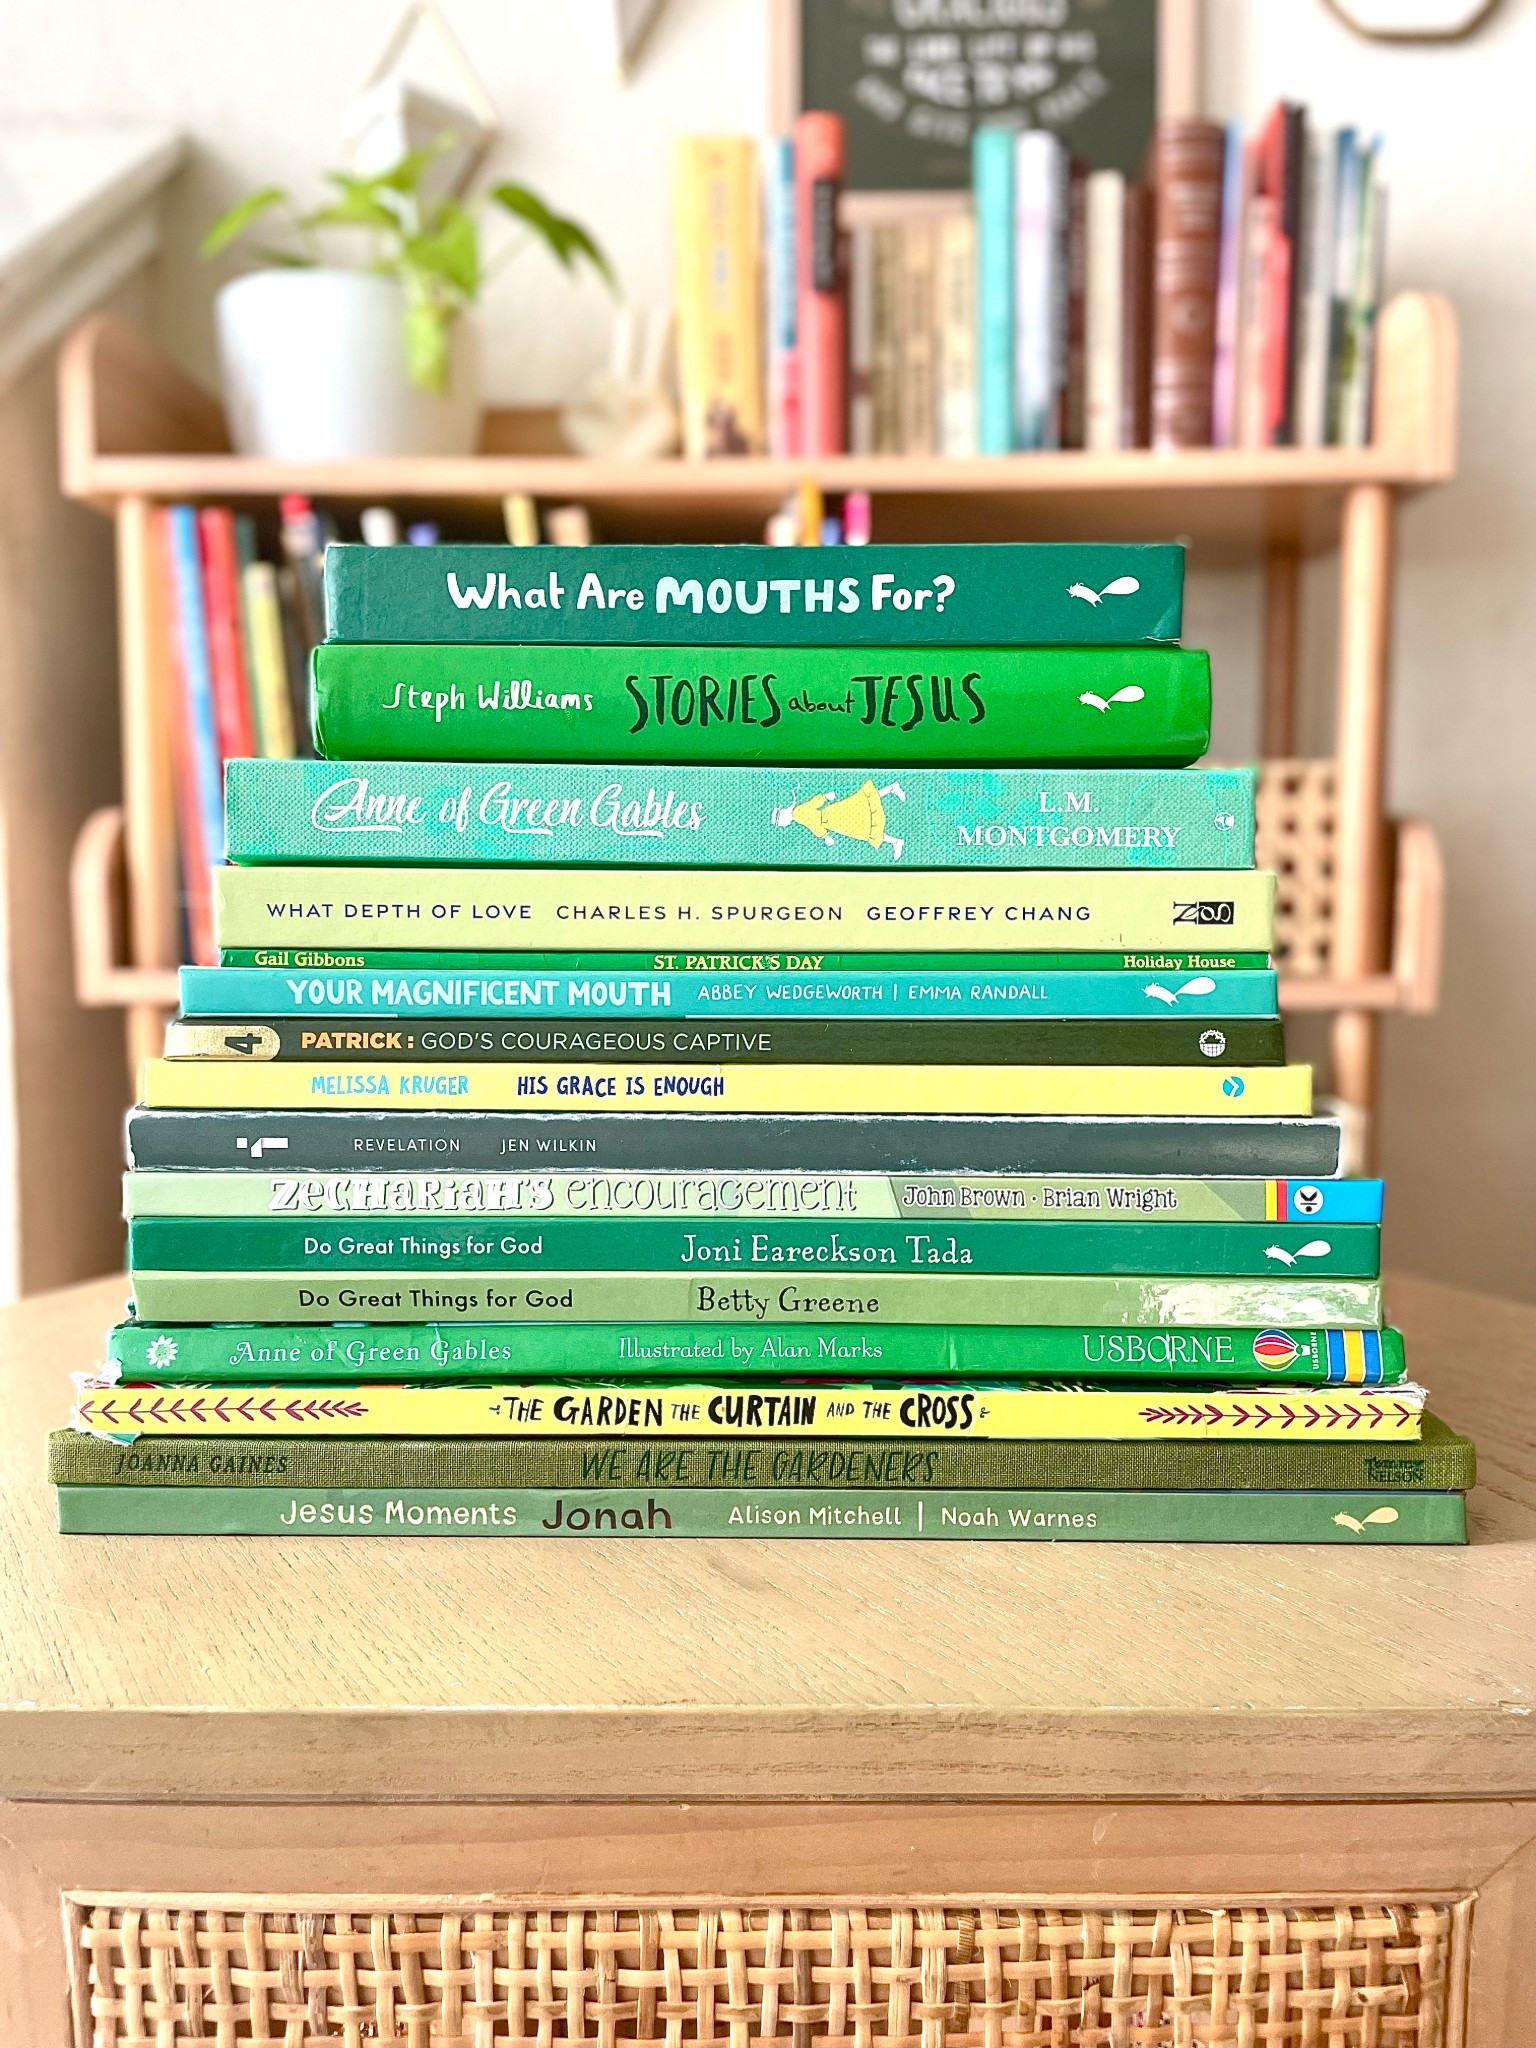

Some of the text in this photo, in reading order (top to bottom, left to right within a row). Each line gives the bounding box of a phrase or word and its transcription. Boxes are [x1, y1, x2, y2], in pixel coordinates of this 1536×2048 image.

[447, 572, 955, 614] What Are MOUTHS For?
[383, 680, 592, 722] Steph Williams
[626, 673, 986, 733] STORIES about JESUS
[311, 778, 706, 838] Anne of Green Gables
[1039, 792, 1098, 812] L.M.
[957, 826, 1181, 847] MONTGOMERY
[267, 904, 530, 918] WHAT DEPTH OF LOVE
[557, 906, 841, 920] CHARLES H. SPURGEON
[867, 907, 1089, 920] GEOFFREY CHANG
[254, 950, 365, 968] Gail Gibbons
[653, 955, 825, 970] ST. PATRICK'S DAY
[1123, 955, 1236, 971] Holiday House
[286, 979, 670, 1005] YOUR MAGNIFICENT MOUTH
[698, 984, 757, 1000] ABBEY
[766, 985, 882, 1000] WEDGEWORTH
[909, 986, 961, 999] EMMA
[971, 985, 1047, 999] RANDALL
[225, 1033, 262, 1056] 4
[422, 1033, 493, 1049] GOD'S
[502, 1033, 665, 1050] COURAGEOUS
[674, 1034, 771, 1050] CAPTIVE
[312, 1075, 469, 1096] MELISSA KRUGER
[518, 1076, 723, 1097] HIS GRACE IS ENOUGH
[355, 1139, 459, 1151] REVELATION
[500, 1139, 595, 1154] JEN WILKIN
[904, 1187, 954, 1205] John
[959, 1188, 1024, 1206] Brown
[1044, 1188, 1100, 1207] Brian
[1107, 1189, 1176, 1211] Wright
[305, 1236, 541, 1259] Do Great Things for God
[681, 1234, 973, 1264] Joni Eareckson Tada
[299, 1289, 572, 1312] Do Great Things for God
[697, 1286, 878, 1320] Betty Greene
[230, 1339, 513, 1367] Anne of Green Gables
[620, 1337, 882, 1364] Illustrated by Alan Marks
[1083, 1334, 1234, 1366] USBORNE
[508, 1394, 974, 1429] THE GARDEN THE CURTAIN AND THE CROSS
[115, 1454, 288, 1476] JOANNA GAINES
[581, 1449, 938, 1482] WE ARE THE GARDENERS
[1368, 1469, 1424, 1483] NELSON
[281, 1500, 516, 1525] Jesus Moments
[542, 1499, 671, 1530] Jonah
[729, 1505, 800, 1524] Alison
[810, 1506, 901, 1525] Mitchell
[942, 1508, 998, 1526] Noah
[1008, 1510, 1096, 1527] Warnes
